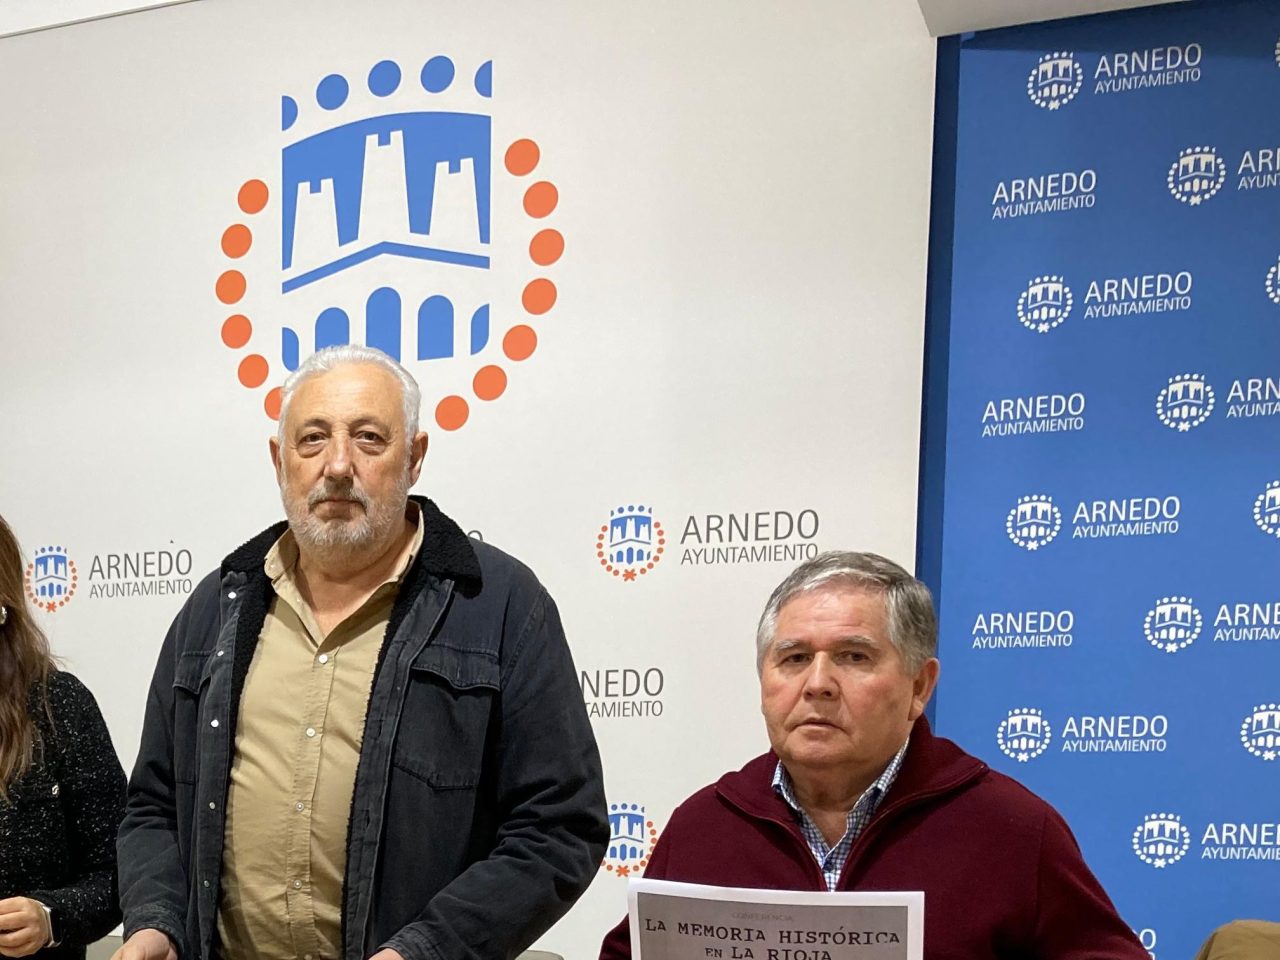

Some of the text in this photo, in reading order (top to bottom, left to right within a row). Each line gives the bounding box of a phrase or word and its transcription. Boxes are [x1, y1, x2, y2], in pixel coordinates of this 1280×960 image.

[1095, 43, 1201, 78] ARNEDO
[1095, 68, 1201, 94] AYUNTAMIENTO
[992, 170, 1096, 205] ARNEDO
[992, 194, 1095, 219] AYUNTAMIENTO
[1084, 272, 1192, 303] ARNEDO
[1084, 296, 1191, 319] AYUNTAMIENTO
[982, 393, 1085, 423] ARNEDO
[982, 416, 1084, 437] AYUNTAMIENTO
[1072, 497, 1180, 524] ARNEDO
[680, 509, 819, 544] ARNEDO
[1072, 520, 1178, 539] AYUNTAMIENTO
[89, 549, 192, 580] ARNEDO
[681, 543, 818, 565] AYUNTAMIENTO
[90, 579, 192, 598] AYUNTAMIENTO
[972, 610, 1074, 636] ARNEDO
[972, 634, 1072, 649] AYUNTAMIENTO
[1062, 715, 1168, 738] ARNEDO
[1062, 738, 1166, 753] AYUNTAMIENTO
[646, 919, 900, 945] LA MEMORIA HISTÓRICA
[705, 948, 722, 958] EN
[732, 947, 754, 960] LA
